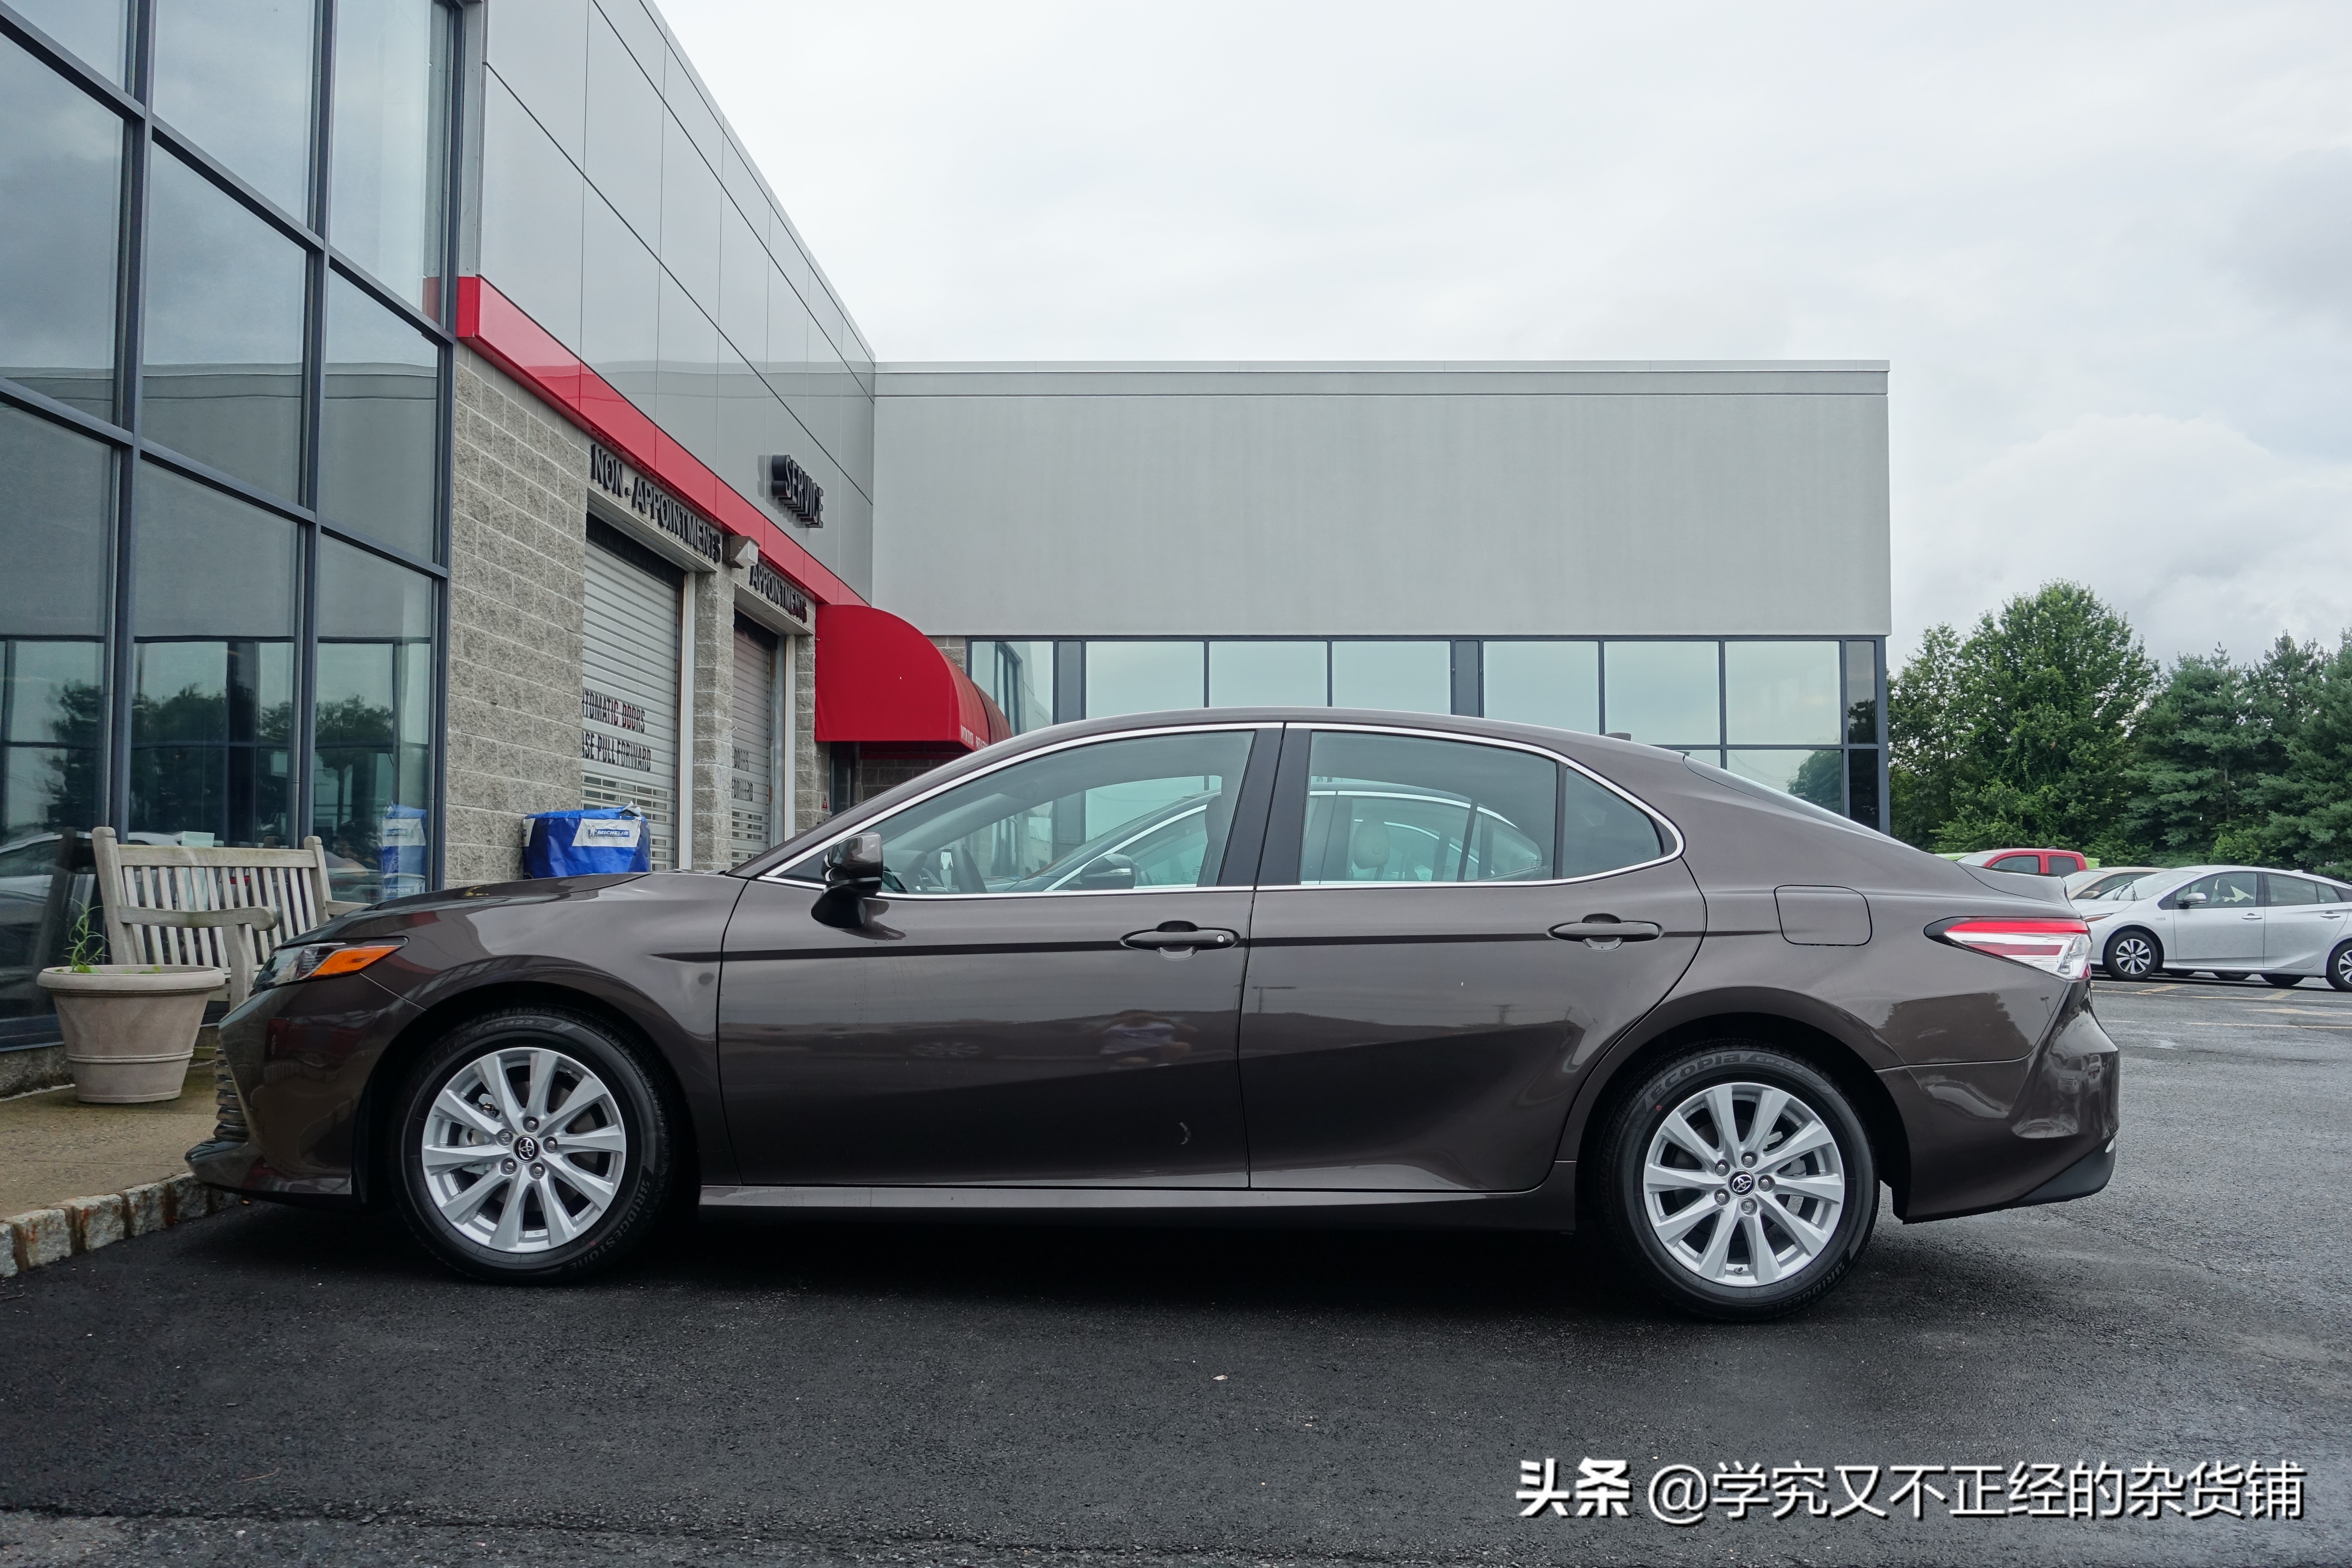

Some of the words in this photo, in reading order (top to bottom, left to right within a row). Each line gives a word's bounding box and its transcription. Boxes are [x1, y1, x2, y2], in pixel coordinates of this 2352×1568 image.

[777, 454, 824, 528] SERVICE
[749, 564, 807, 624] APPOINTMENTS
[582, 690, 619, 726] TOMATIC
[622, 702, 645, 733] DOORS
[597, 735, 616, 764] PULL
[616, 740, 651, 772] FORWARD
[1755, 1056, 1802, 1074] EP422
[569, 1179, 650, 1271] BRIDGESTONE
[1755, 1261, 1845, 1314] BRIDGESTO
